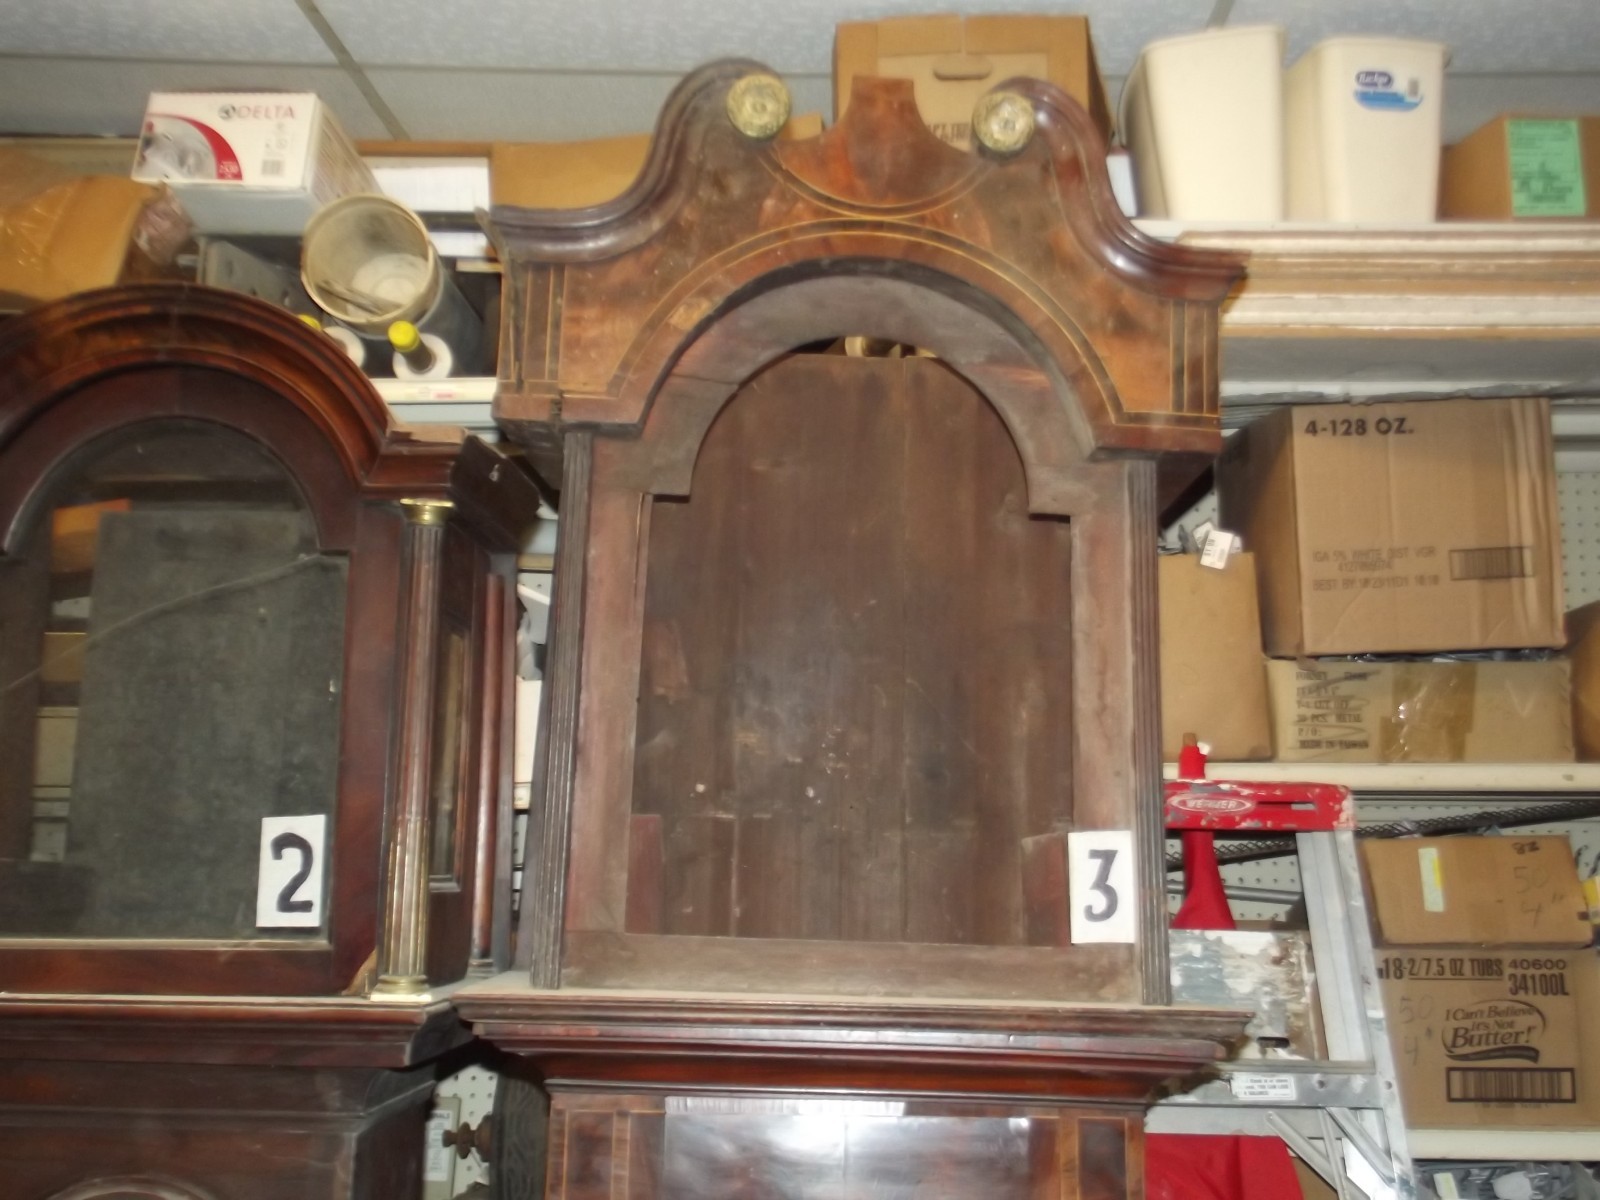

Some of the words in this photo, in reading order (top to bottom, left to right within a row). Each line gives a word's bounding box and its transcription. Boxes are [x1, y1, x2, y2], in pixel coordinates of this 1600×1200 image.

[237, 104, 295, 120] DELTA
[1303, 418, 1367, 437] 4-128
[1374, 416, 1415, 436] OZ.
[270, 832, 314, 913] 2
[1083, 848, 1119, 923] 3
[1382, 957, 1446, 980] 18-2/7.5
[1449, 957, 1465, 977] OZ
[1468, 957, 1504, 977] TUBS
[1508, 958, 1567, 971] 40600
[1508, 972, 1570, 996] 34100L
[1452, 1007, 1485, 1022] Can't
[1487, 1004, 1537, 1019] Believe
[1493, 1018, 1516, 1030] Not
[1450, 1025, 1533, 1049] Butter!
